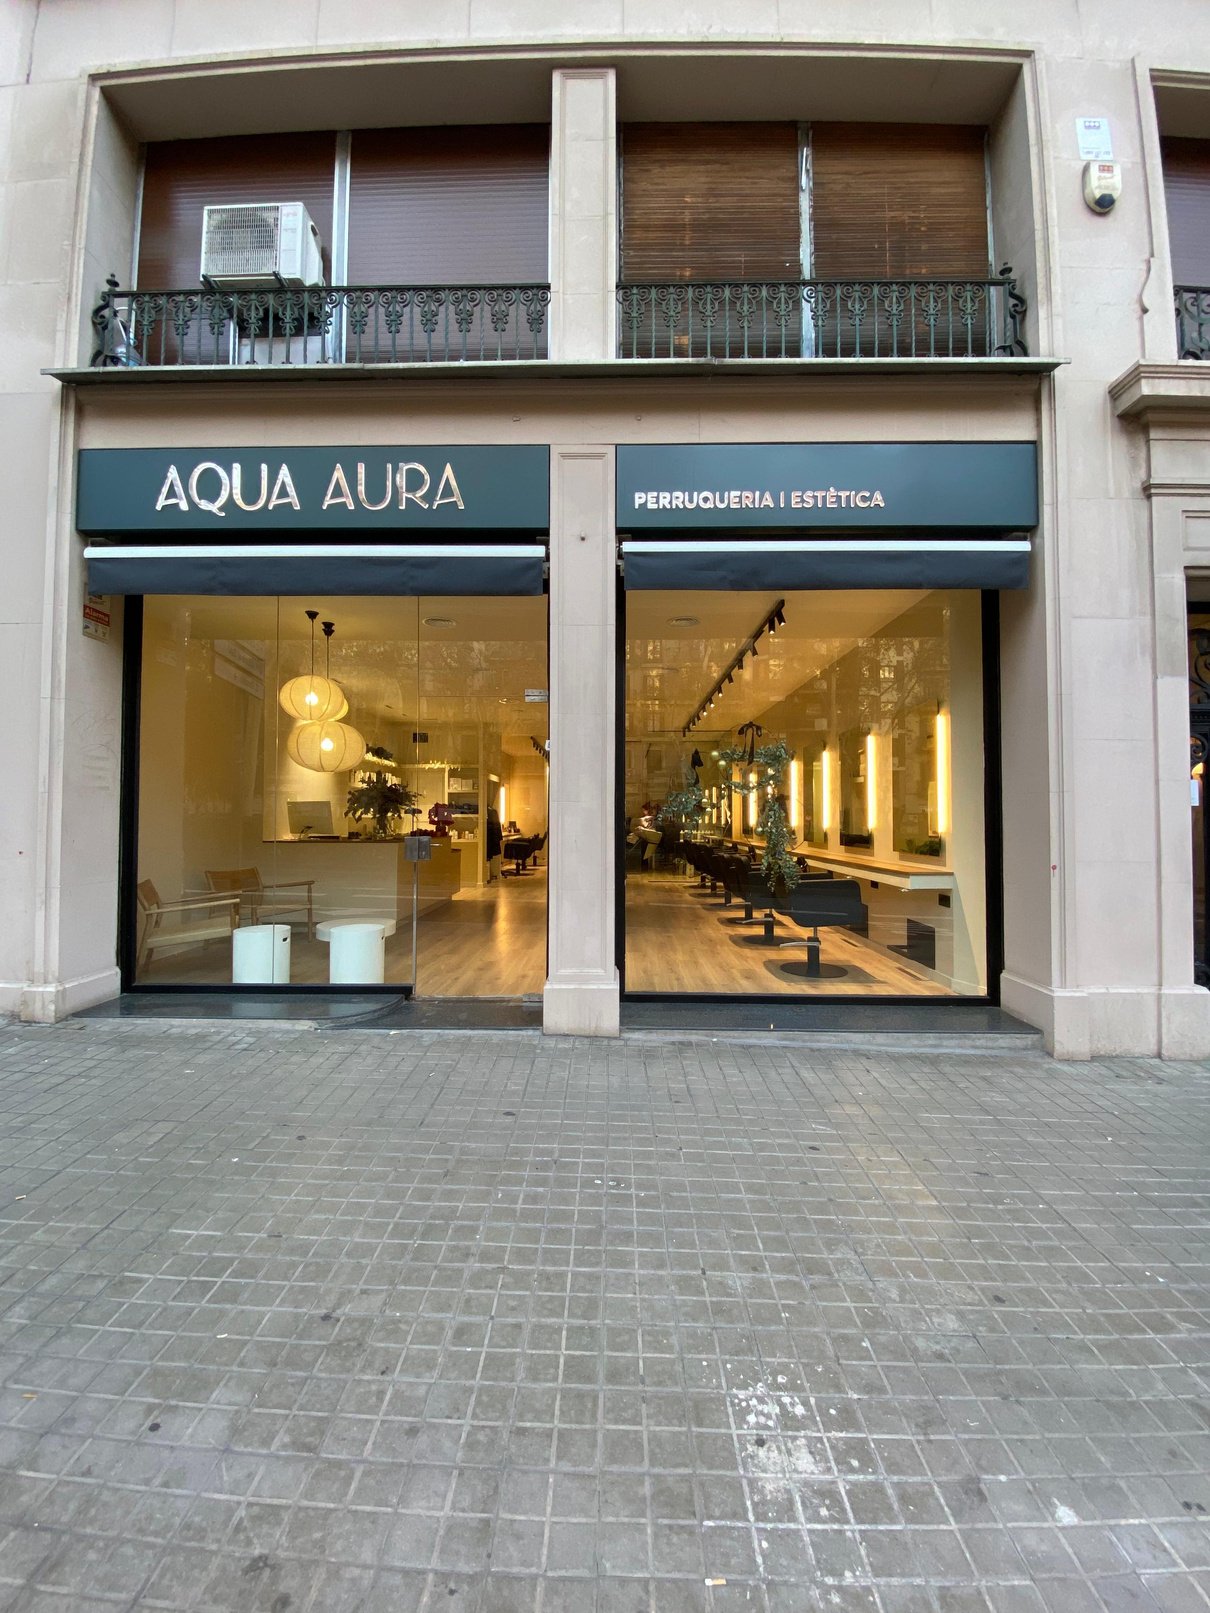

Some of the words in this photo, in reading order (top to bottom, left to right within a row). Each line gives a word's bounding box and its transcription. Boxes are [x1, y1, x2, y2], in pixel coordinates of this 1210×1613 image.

[155, 462, 301, 517] AQUA
[321, 462, 465, 510] AURA
[634, 491, 774, 510] PERRUQUERIA
[791, 486, 886, 509] ESTÈTICA
